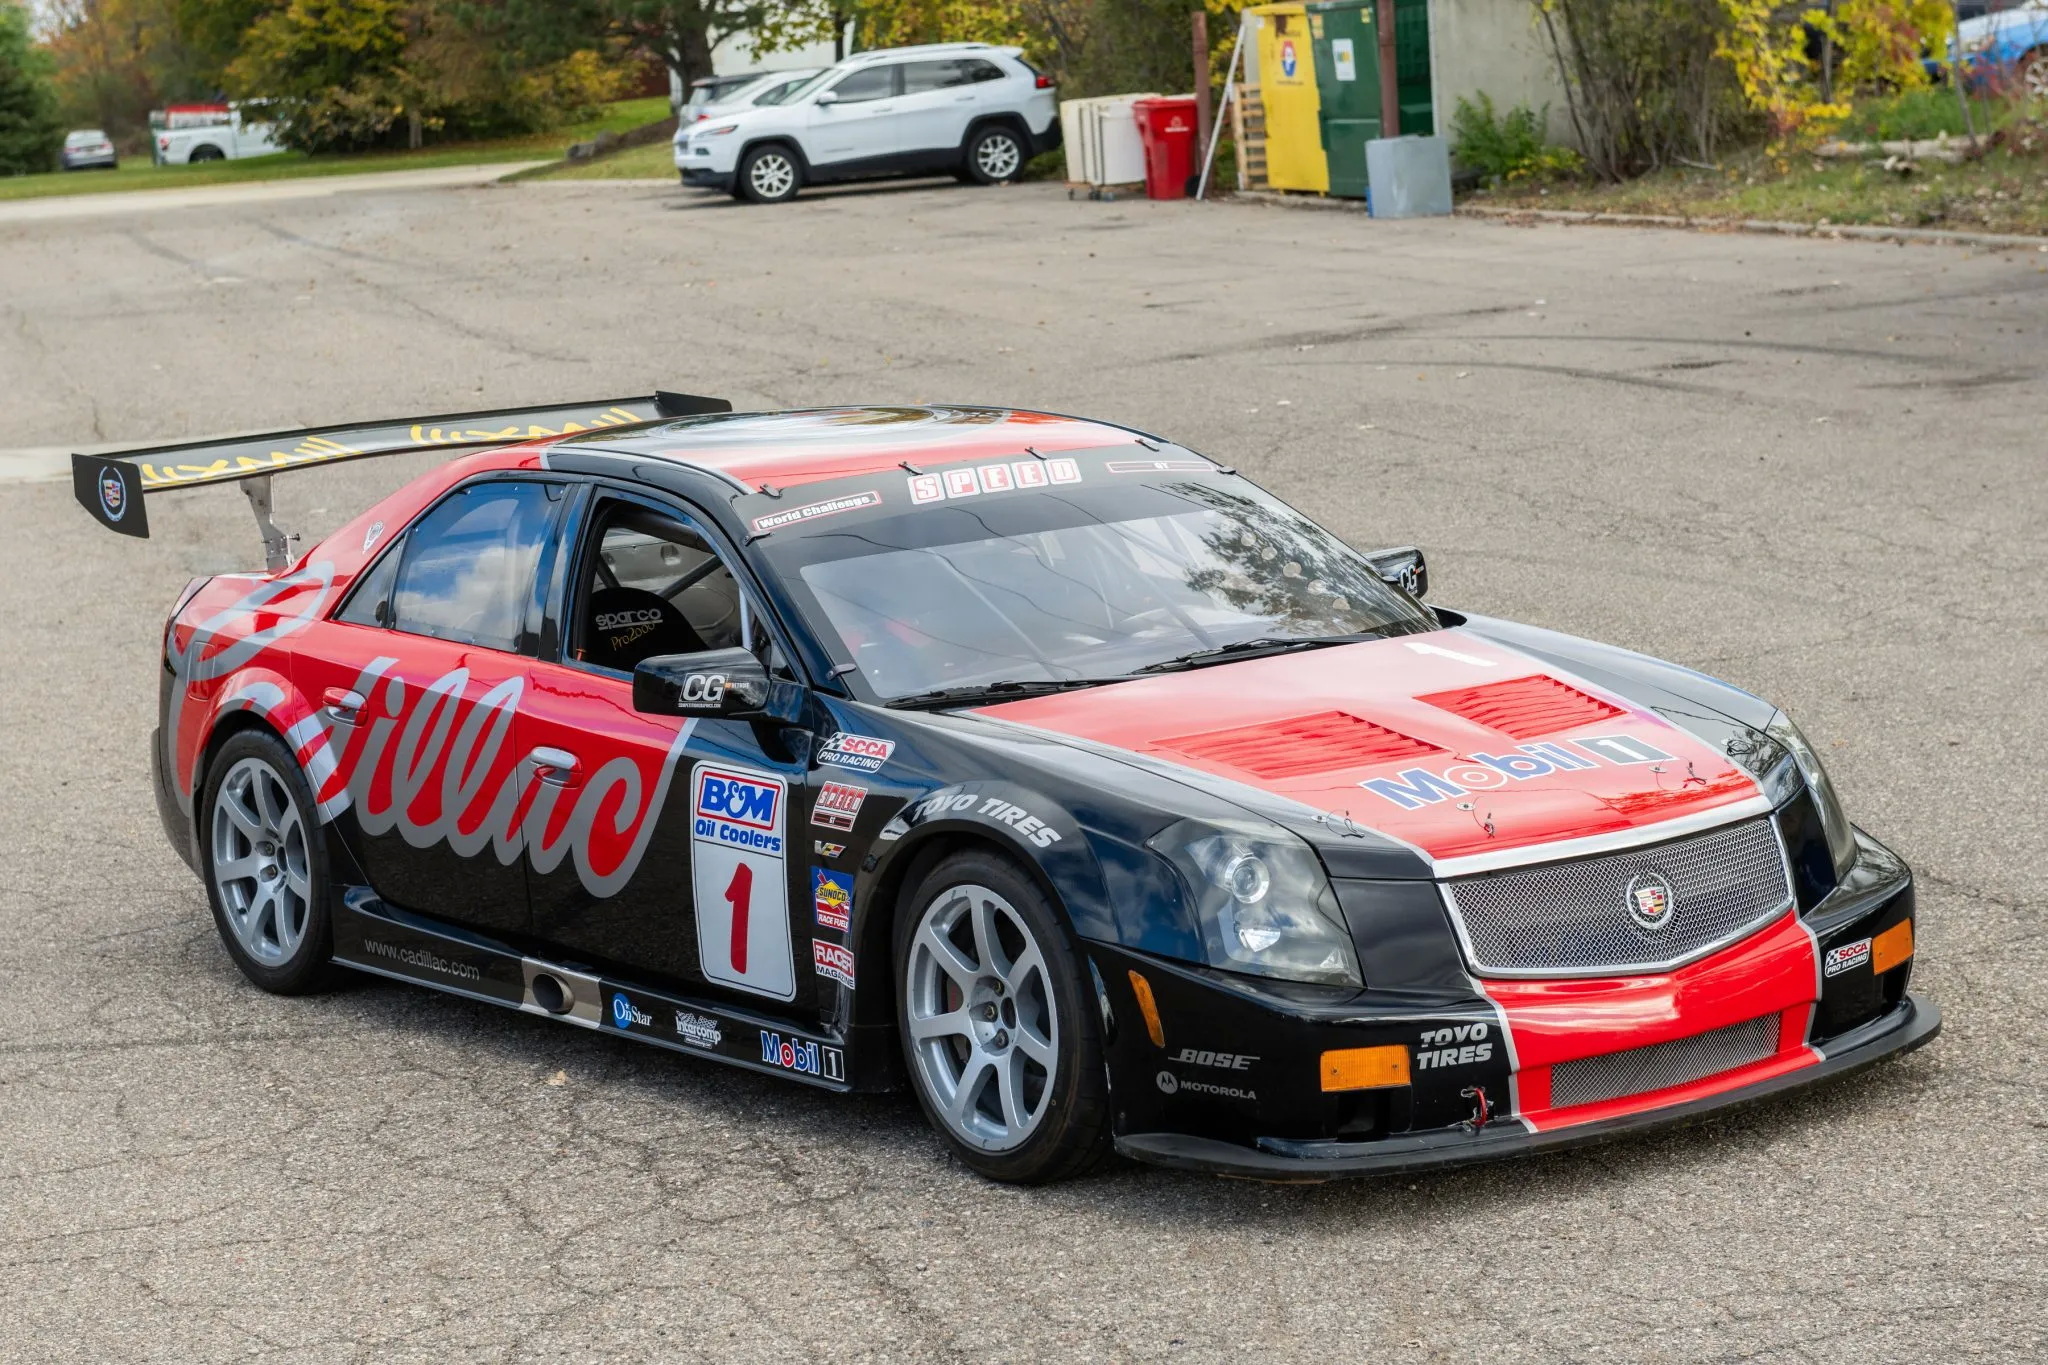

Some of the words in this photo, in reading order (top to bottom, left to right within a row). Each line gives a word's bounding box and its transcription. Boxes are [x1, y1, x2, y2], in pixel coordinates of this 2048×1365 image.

[911, 459, 1077, 501] SPEED
[758, 510, 802, 528] World
[802, 495, 870, 517] Challenge
[595, 608, 662, 630] sparco
[1404, 642, 1498, 667] 1
[682, 674, 726, 701] CG
[819, 751, 840, 762] PRO
[840, 754, 881, 769] RACING
[842, 737, 887, 758] SCCA
[1357, 741, 1601, 811] Mobil
[1595, 737, 1652, 762] 1
[701, 777, 775, 822] B&M
[819, 788, 862, 811] SPEED
[912, 794, 979, 823] TOYO
[977, 797, 1063, 848] TIRES
[695, 819, 716, 837] Oil
[720, 824, 781, 851] Coolers
[819, 886, 848, 902] SUNOCO
[724, 862, 753, 975] 1
[819, 914, 835, 925] RACE
[364, 939, 480, 981] www.cadillac.com
[815, 944, 852, 974] RACER
[1827, 963, 1841, 975] PRO
[1841, 953, 1868, 969] RACING
[1839, 942, 1868, 960] SCCA
[816, 964, 855, 988] MAGAZINE
[613, 998, 653, 1027] OnStar
[675, 1015, 722, 1046] Intercomp
[1419, 1022, 1489, 1048] TOYO
[760, 1029, 821, 1076] Mobil
[1168, 1048, 1261, 1071] BOSE
[1416, 1043, 1493, 1070] TIRES
[1181, 1080, 1257, 1100] MOTOROLA
